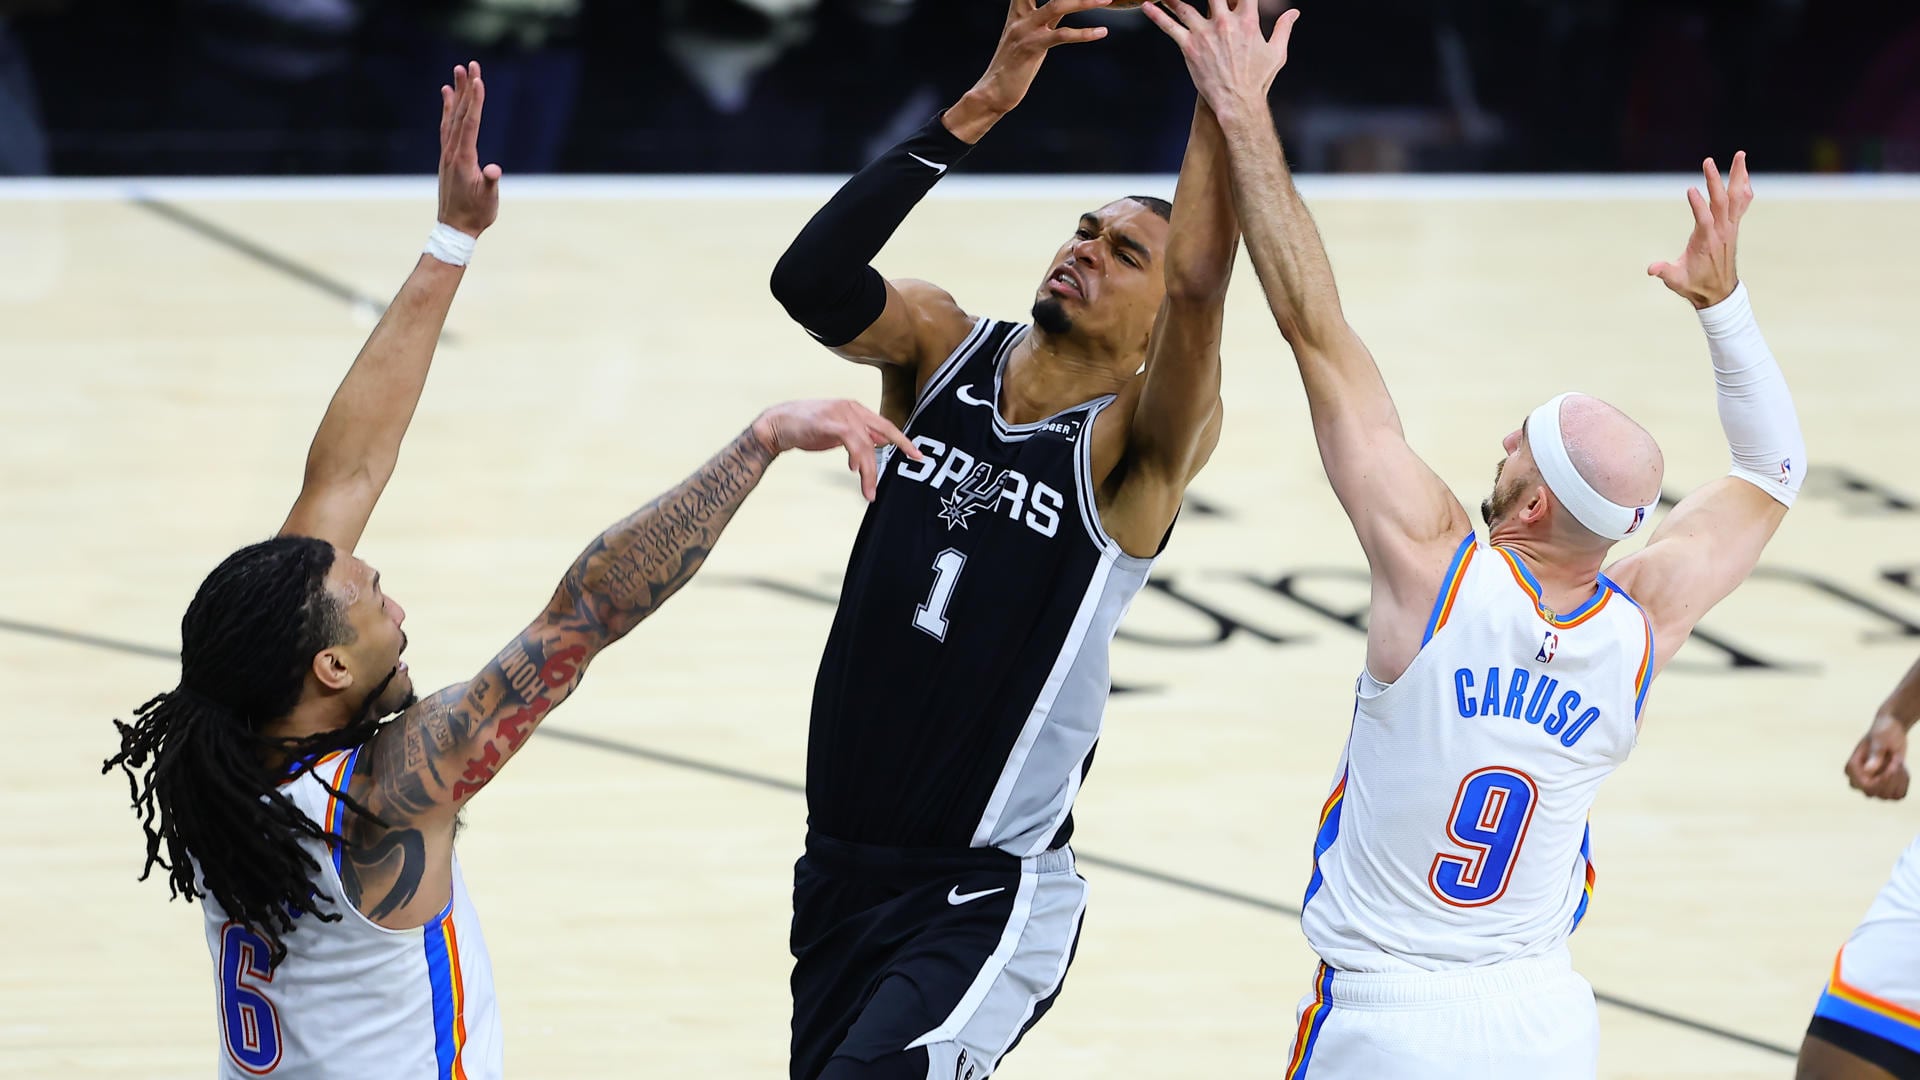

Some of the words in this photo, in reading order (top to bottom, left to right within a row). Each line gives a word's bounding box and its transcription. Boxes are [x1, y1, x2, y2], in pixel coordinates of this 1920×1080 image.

[896, 435, 1064, 538] SPURS
[912, 547, 968, 643] 1
[1454, 667, 1600, 747] CARUSO
[1428, 765, 1538, 908] 9
[219, 920, 283, 1075] 6
